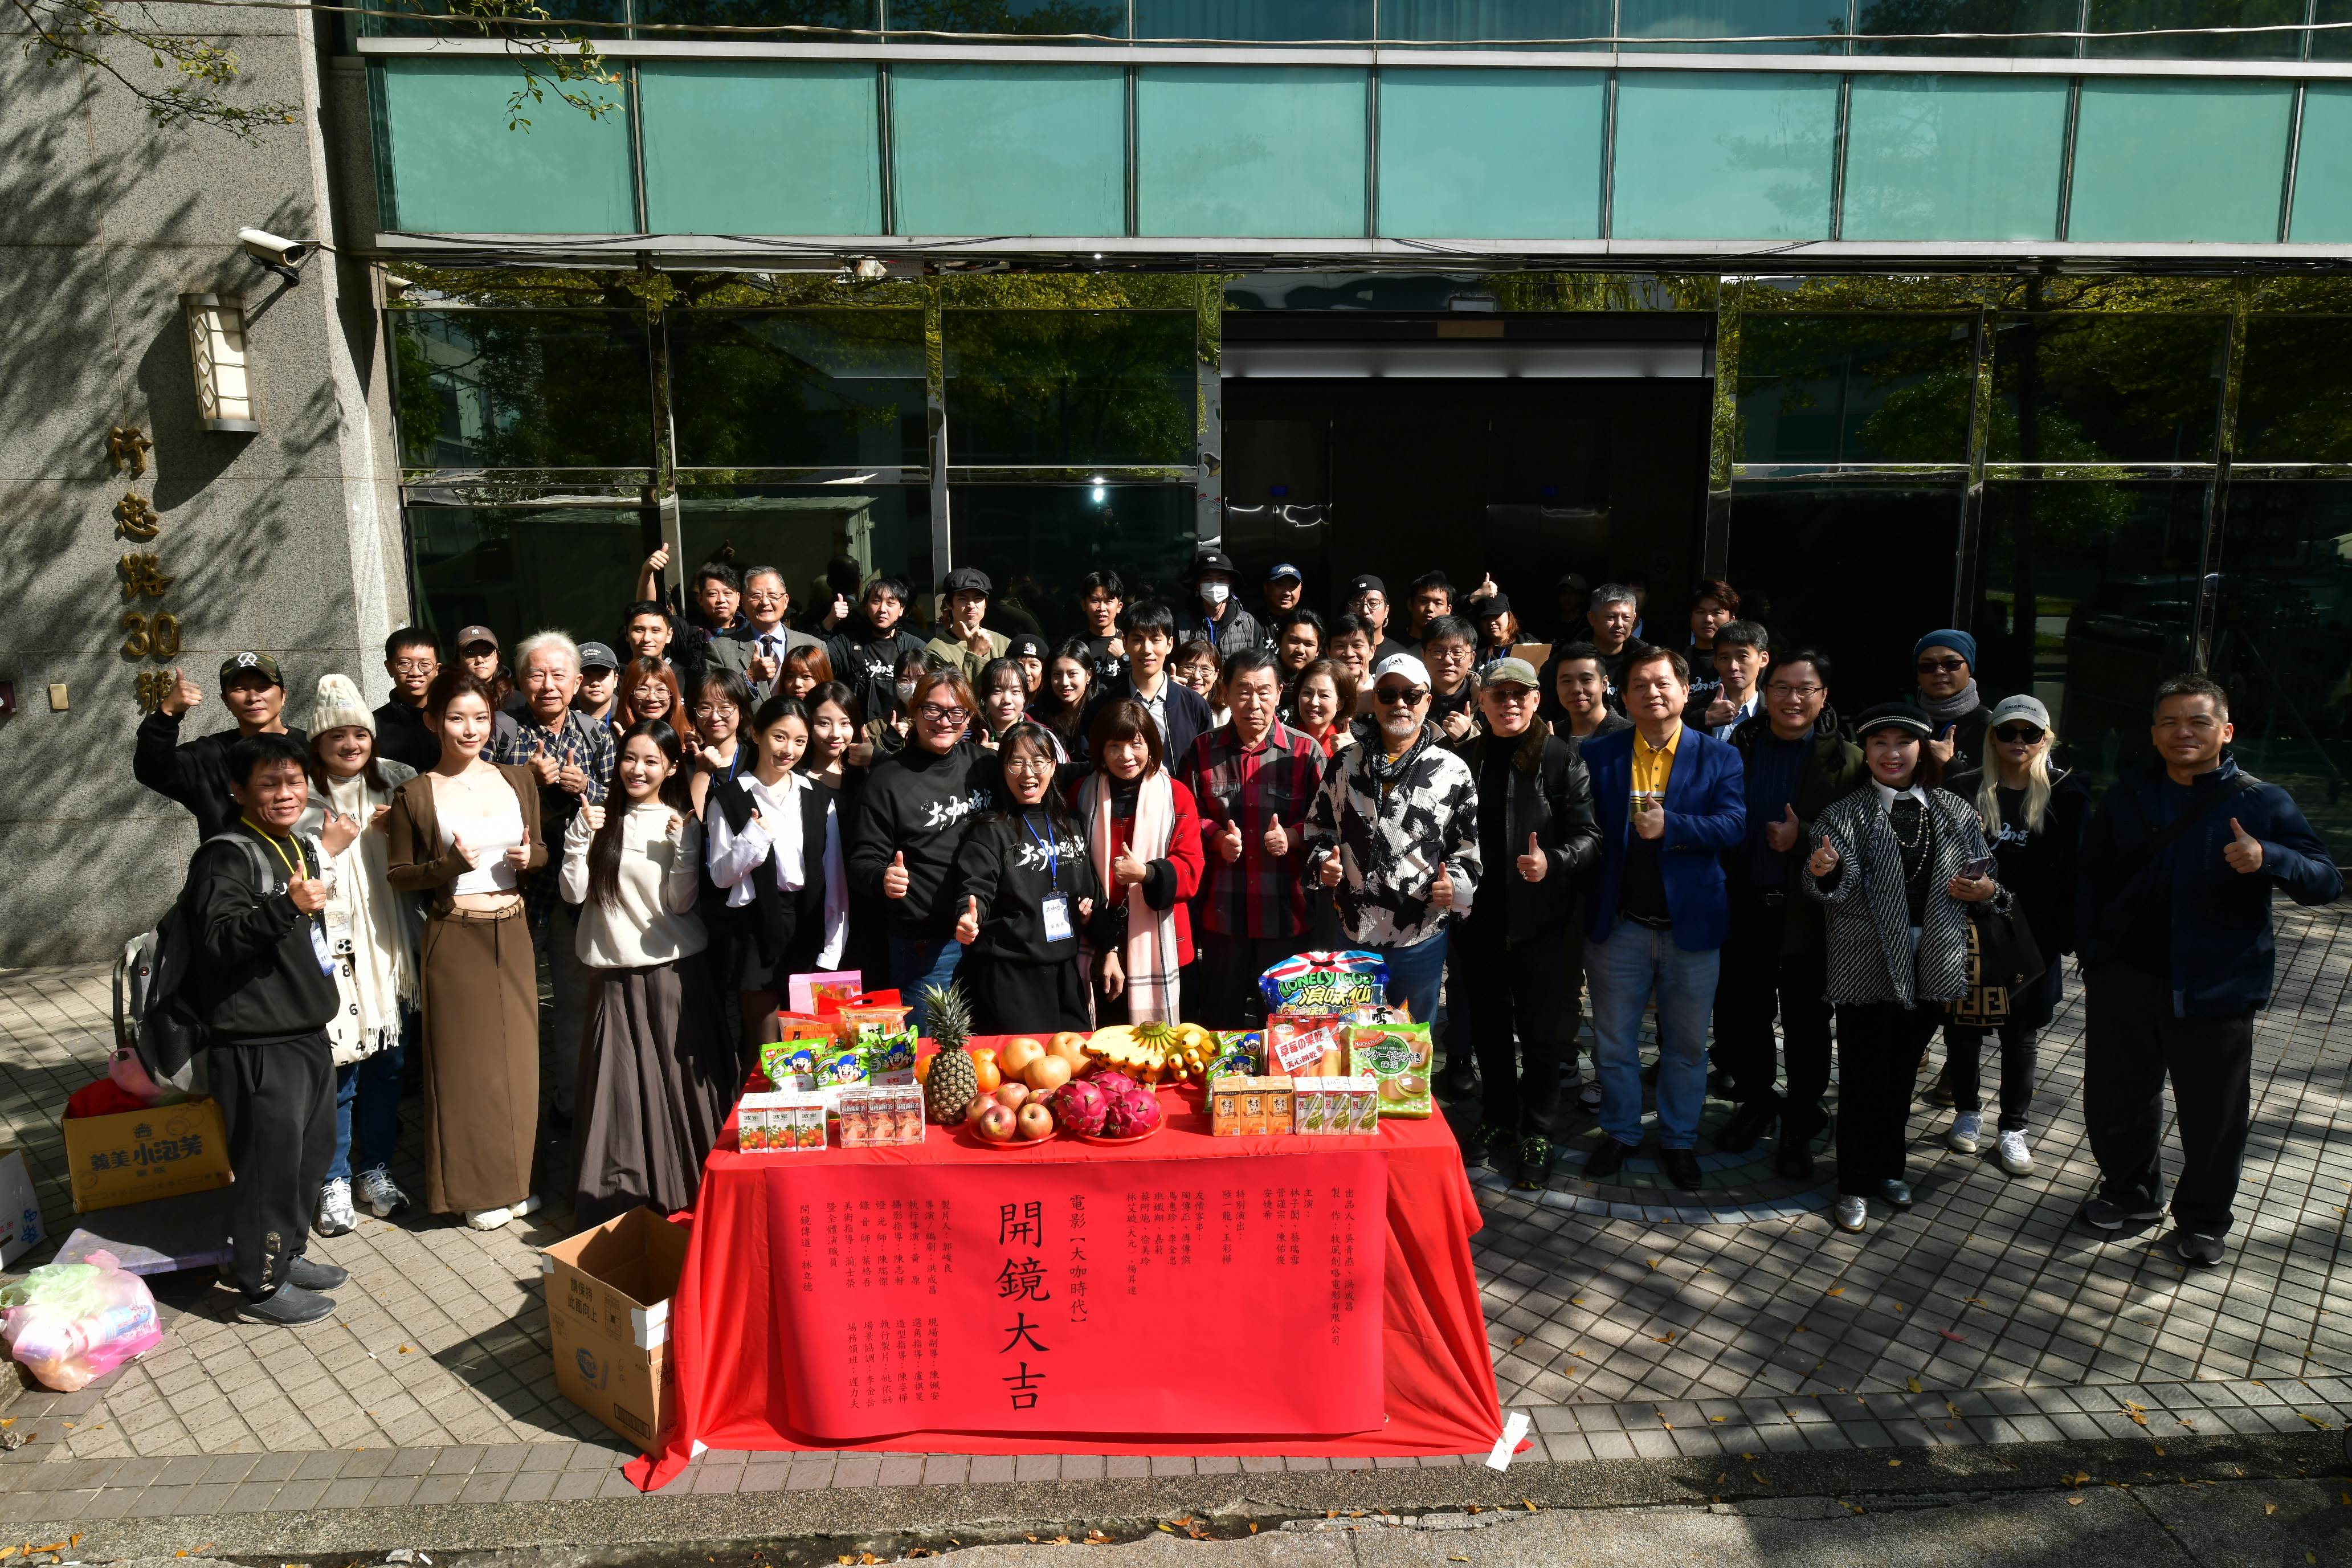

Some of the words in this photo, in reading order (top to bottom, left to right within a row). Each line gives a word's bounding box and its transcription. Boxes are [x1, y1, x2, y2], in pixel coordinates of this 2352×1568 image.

[342, 964, 350, 977] 8
[1279, 971, 1336, 997] LONELY
[1297, 986, 1374, 1007] 浪味仙
[349, 1003, 358, 1015] 6
[1280, 1031, 1324, 1057] 草莓の果乾
[1370, 1035, 1385, 1045] FLAVOR
[1285, 1051, 1317, 1069] 夾心餅乾
[1358, 1050, 1422, 1063] パンケーキどらやき
[1381, 1060, 1399, 1069] 抹茶
[91, 1150, 131, 1171] 義美
[1194, 1191, 1205, 1241] 友情客串：
[1235, 1189, 1246, 1240] 特別演出：
[1304, 1188, 1313, 1218] 主演：
[800, 1204, 814, 1292] 開鏡傳道：林立德
[827, 1202, 839, 1268] 暨全體演職員
[1069, 1194, 1088, 1322] 電影【大咖時代】
[570, 1277, 593, 1302] 請保持
[567, 1293, 598, 1324] 此面向上
[994, 1200, 1051, 1412] 開鏡大吉
